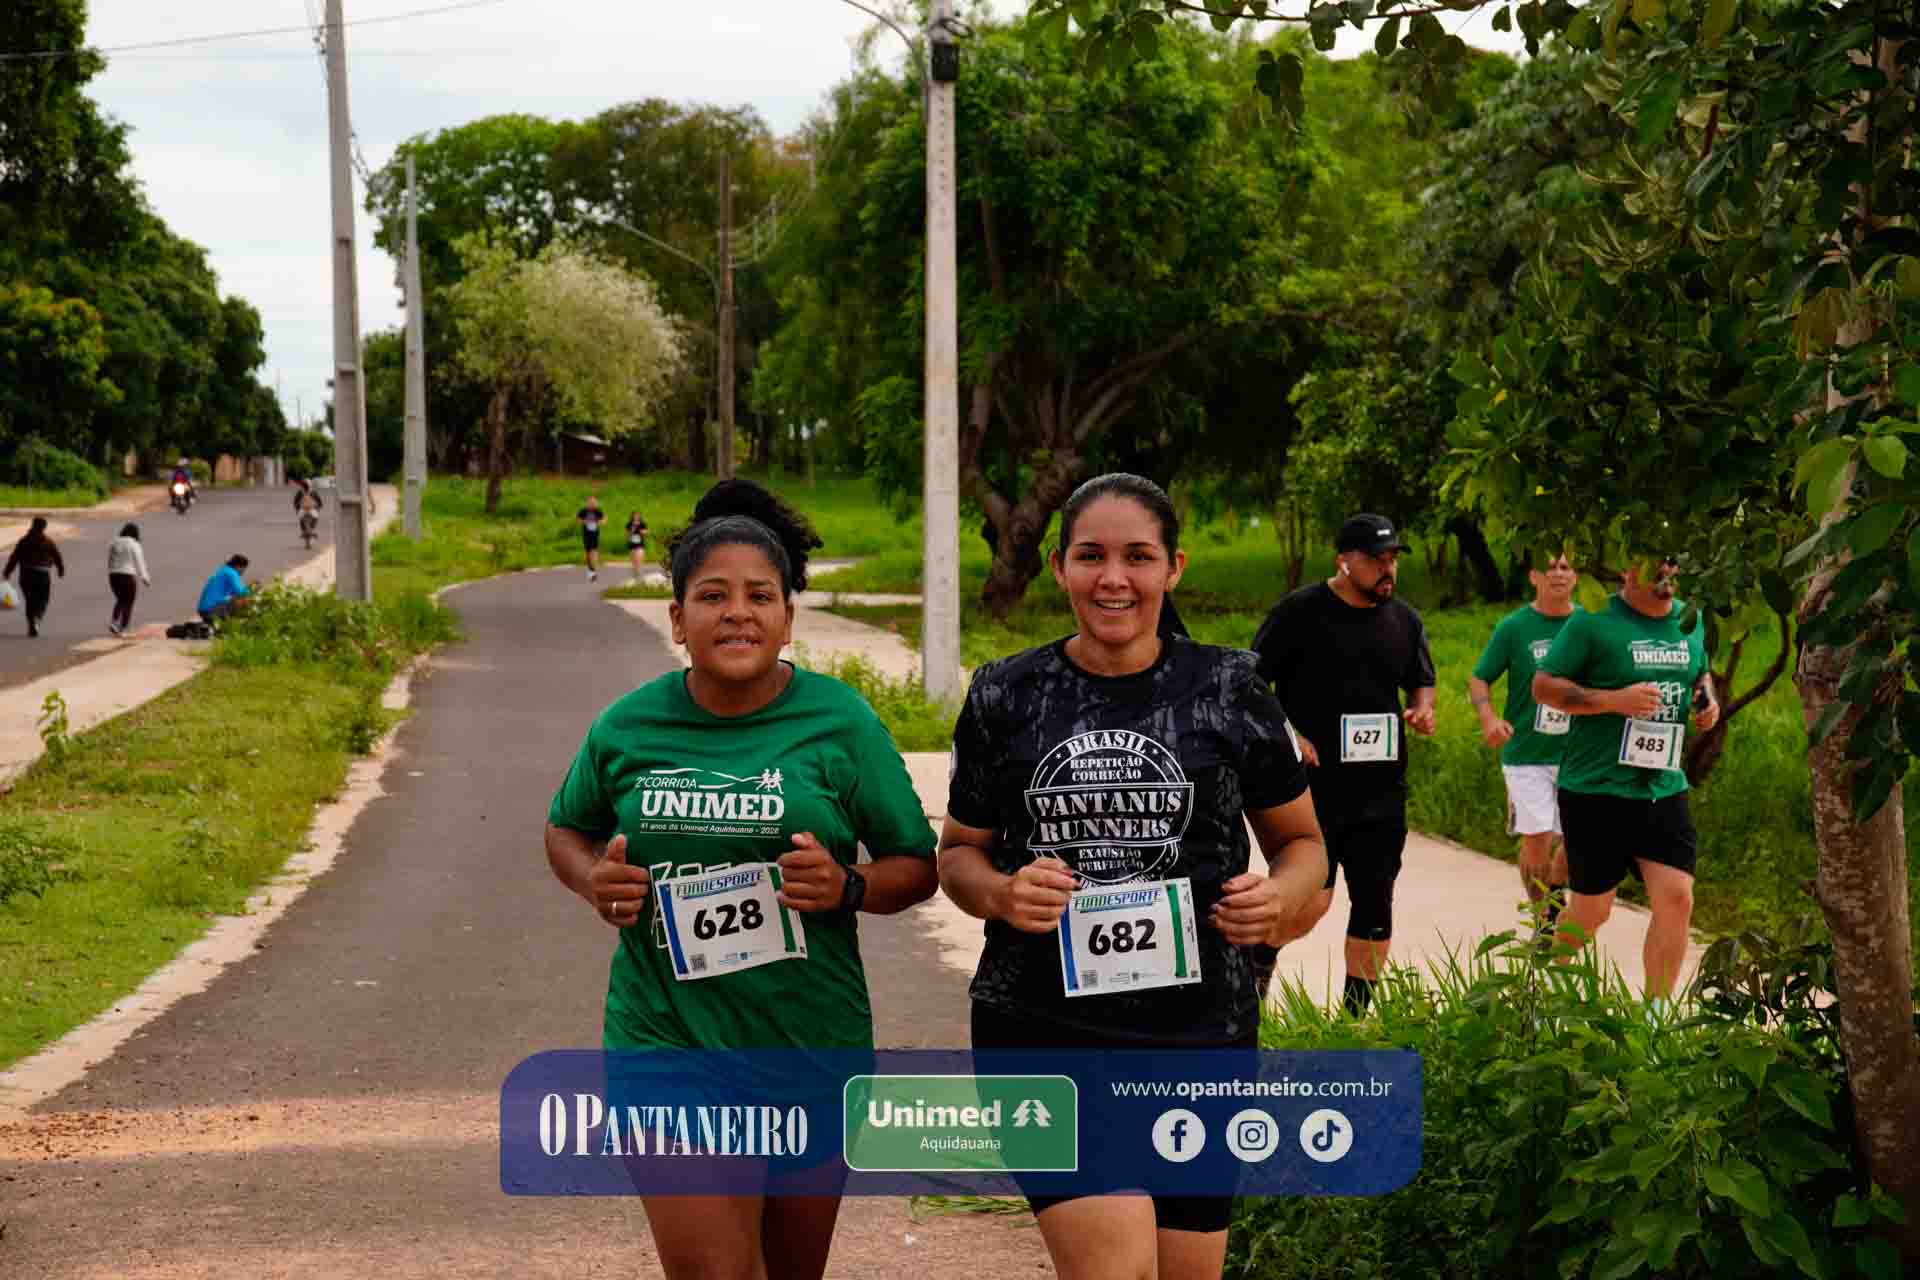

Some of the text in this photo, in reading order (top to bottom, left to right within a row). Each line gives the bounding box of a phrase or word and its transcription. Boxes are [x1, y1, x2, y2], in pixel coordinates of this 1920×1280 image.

[1632, 649, 1690, 665] UNIMED
[1066, 731, 1147, 757] BRASIL
[1353, 730, 1380, 744] 627
[1635, 736, 1665, 752] 483
[1070, 756, 1143, 769] REPETIÇÃO
[1072, 767, 1142, 782] CORREÇÃO
[641, 790, 785, 821] UNIMED
[1035, 791, 1182, 817] PANTANUS
[1039, 817, 1174, 842] RUNNERS
[694, 899, 764, 940] 628
[1088, 918, 1157, 956] 682
